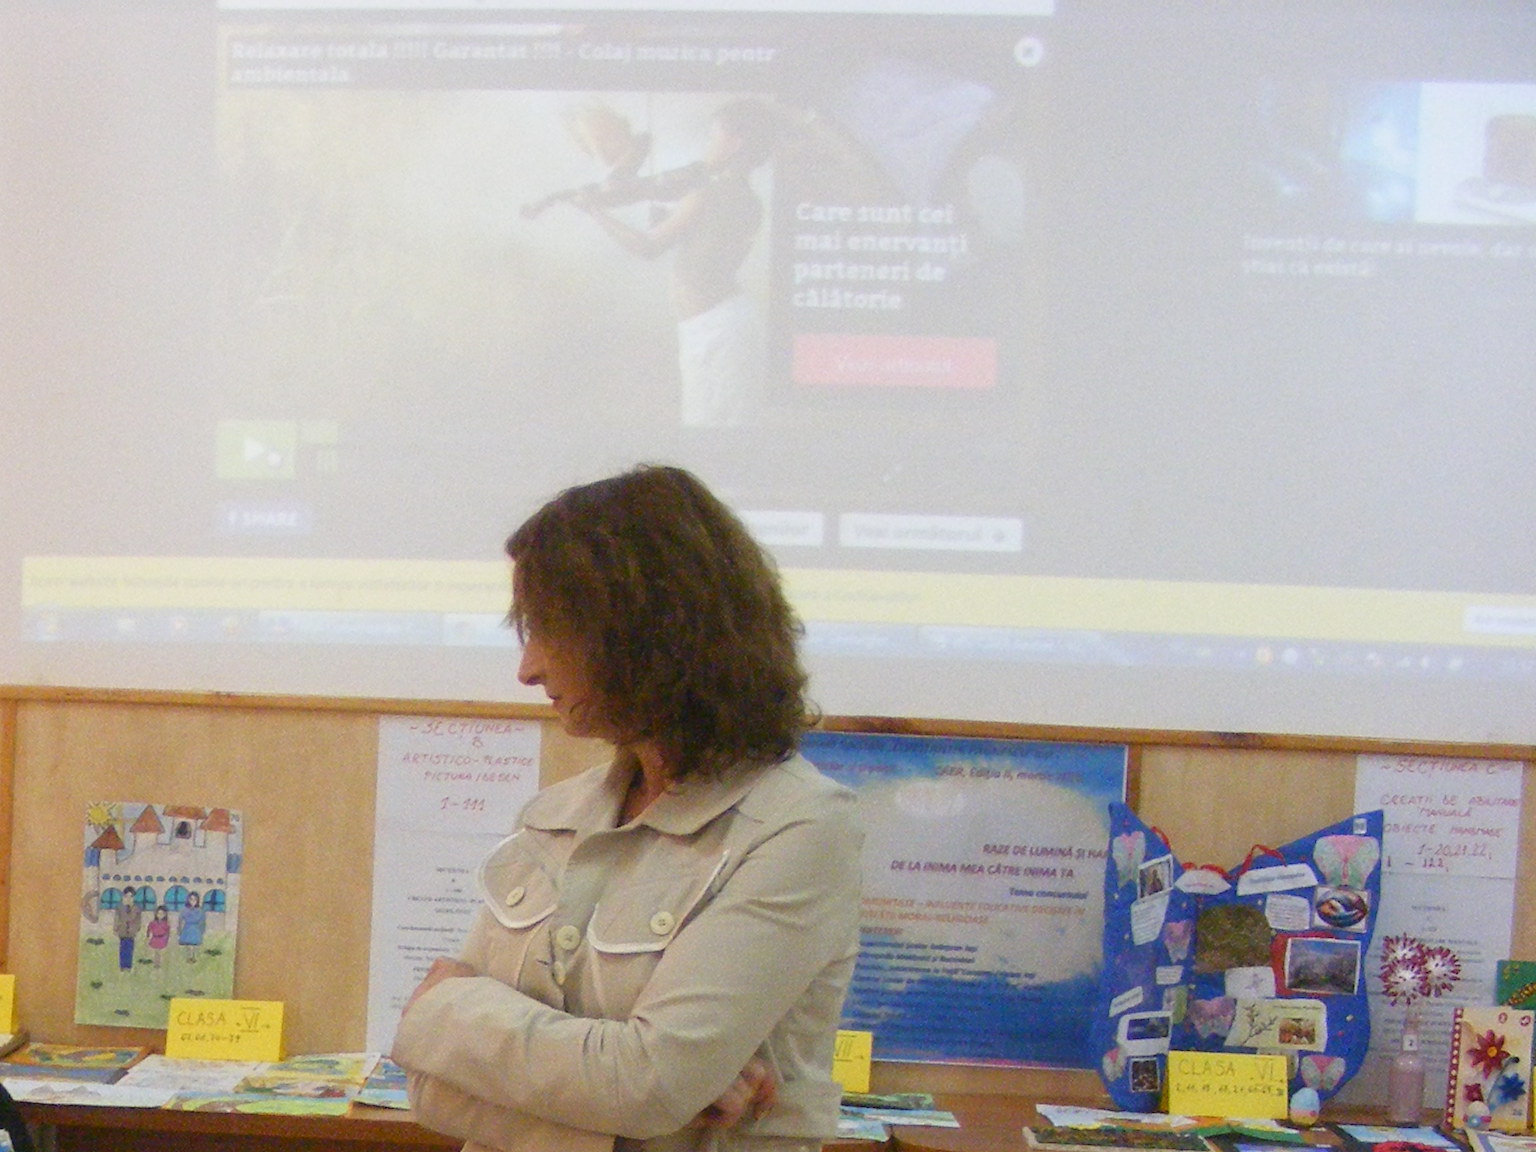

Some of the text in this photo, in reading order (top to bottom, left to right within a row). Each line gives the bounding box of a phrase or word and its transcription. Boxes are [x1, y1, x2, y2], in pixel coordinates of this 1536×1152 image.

[431, 42, 529, 60] Garantat
[577, 43, 631, 63] Colaj
[795, 202, 954, 225] Care sunt cei
[795, 228, 842, 252] mai
[794, 260, 947, 284] parteneri de
[891, 859, 905, 871] DE
[907, 860, 922, 872] LA
[176, 1011, 227, 1026] CLASA
[1178, 1058, 1236, 1077] CLASA
